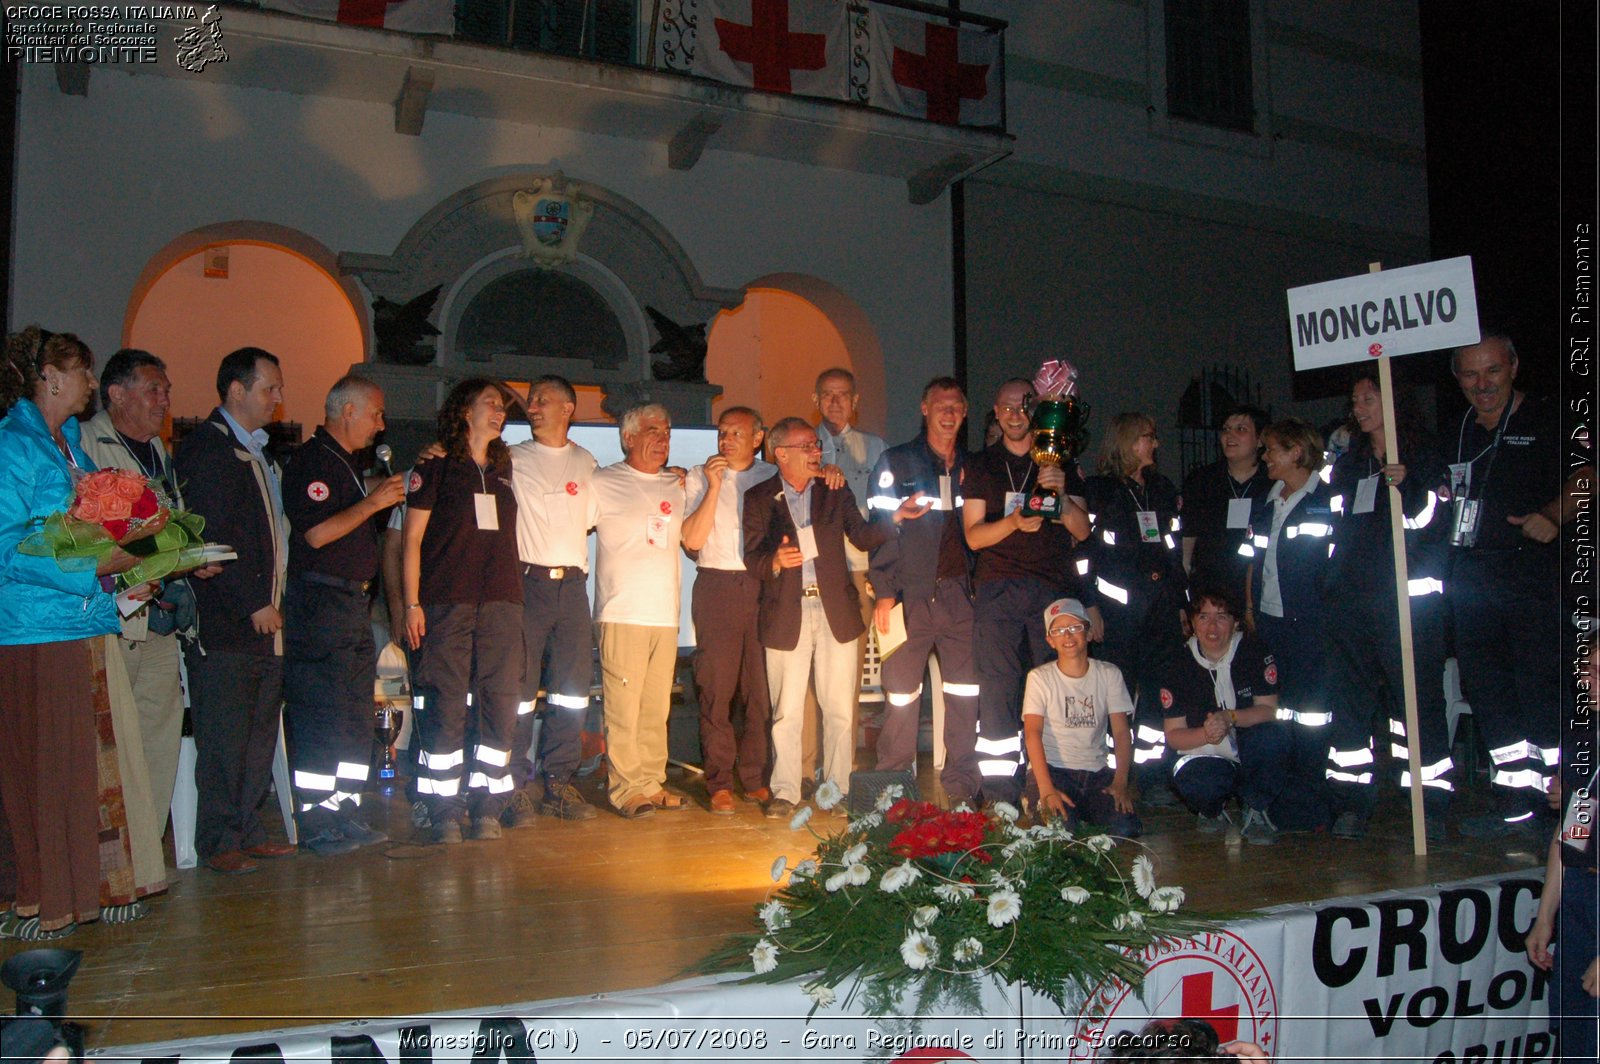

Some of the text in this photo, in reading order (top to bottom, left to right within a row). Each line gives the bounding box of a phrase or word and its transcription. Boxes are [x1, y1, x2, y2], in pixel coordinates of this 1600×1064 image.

[1296, 286, 1457, 347] MONCALVO
[1204, 933, 1272, 1027] ITALIANA
[1312, 878, 1548, 989] CROC
